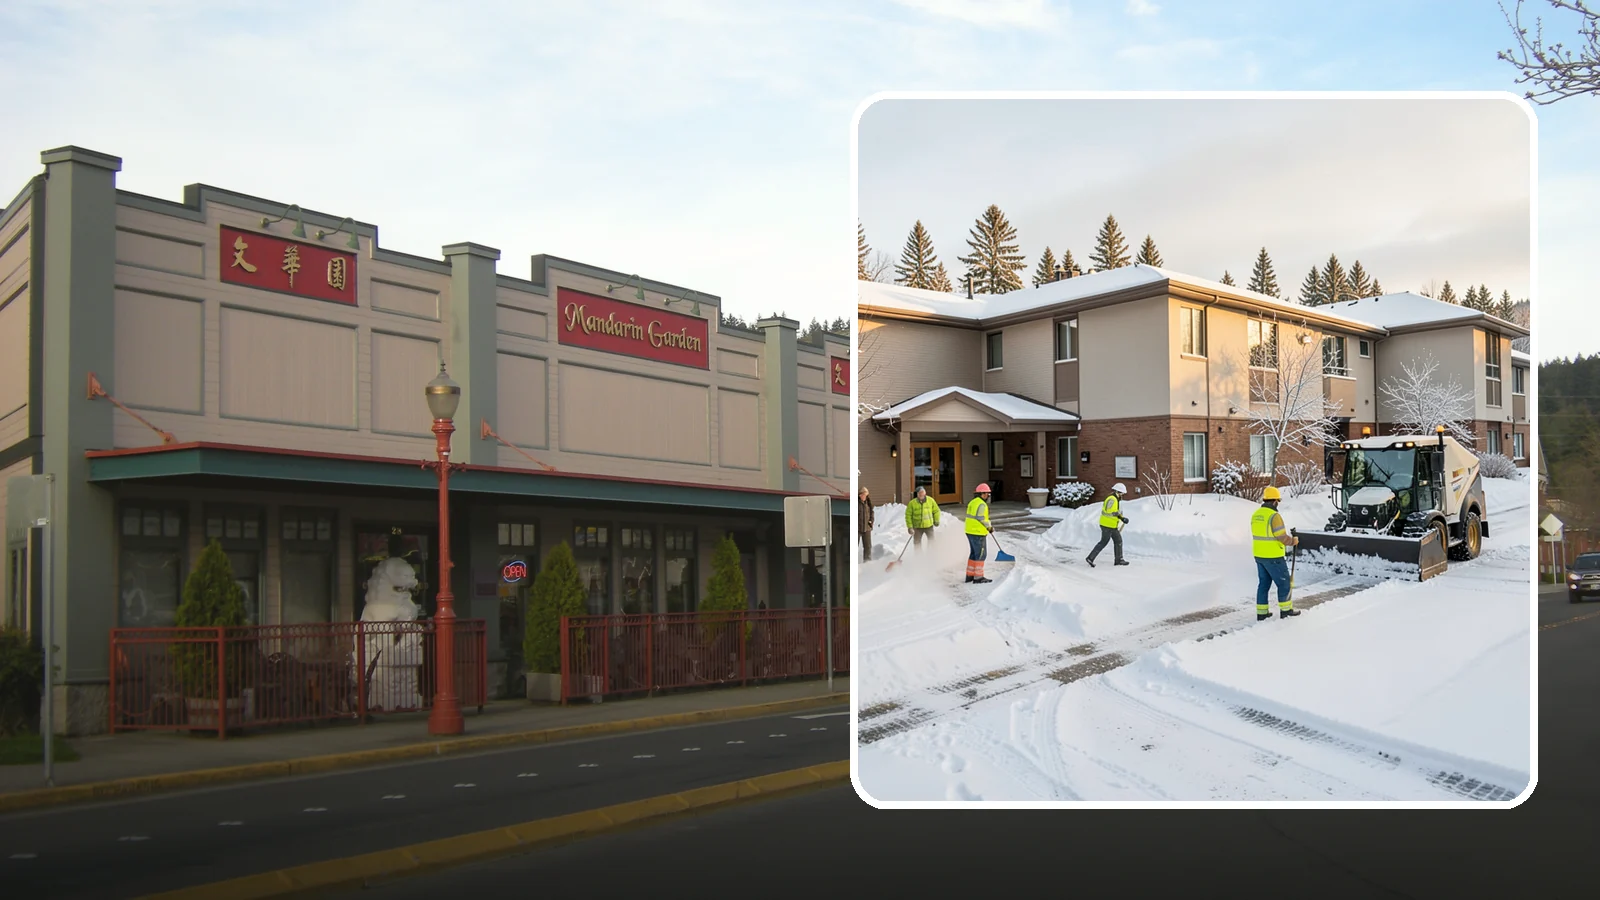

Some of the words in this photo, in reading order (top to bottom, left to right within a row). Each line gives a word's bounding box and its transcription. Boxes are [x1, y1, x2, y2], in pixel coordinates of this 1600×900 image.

[231, 236, 346, 291] 文華園
[565, 302, 644, 341] Mandarin
[647, 320, 701, 352] Garden
[503, 565, 527, 578] OPEN
